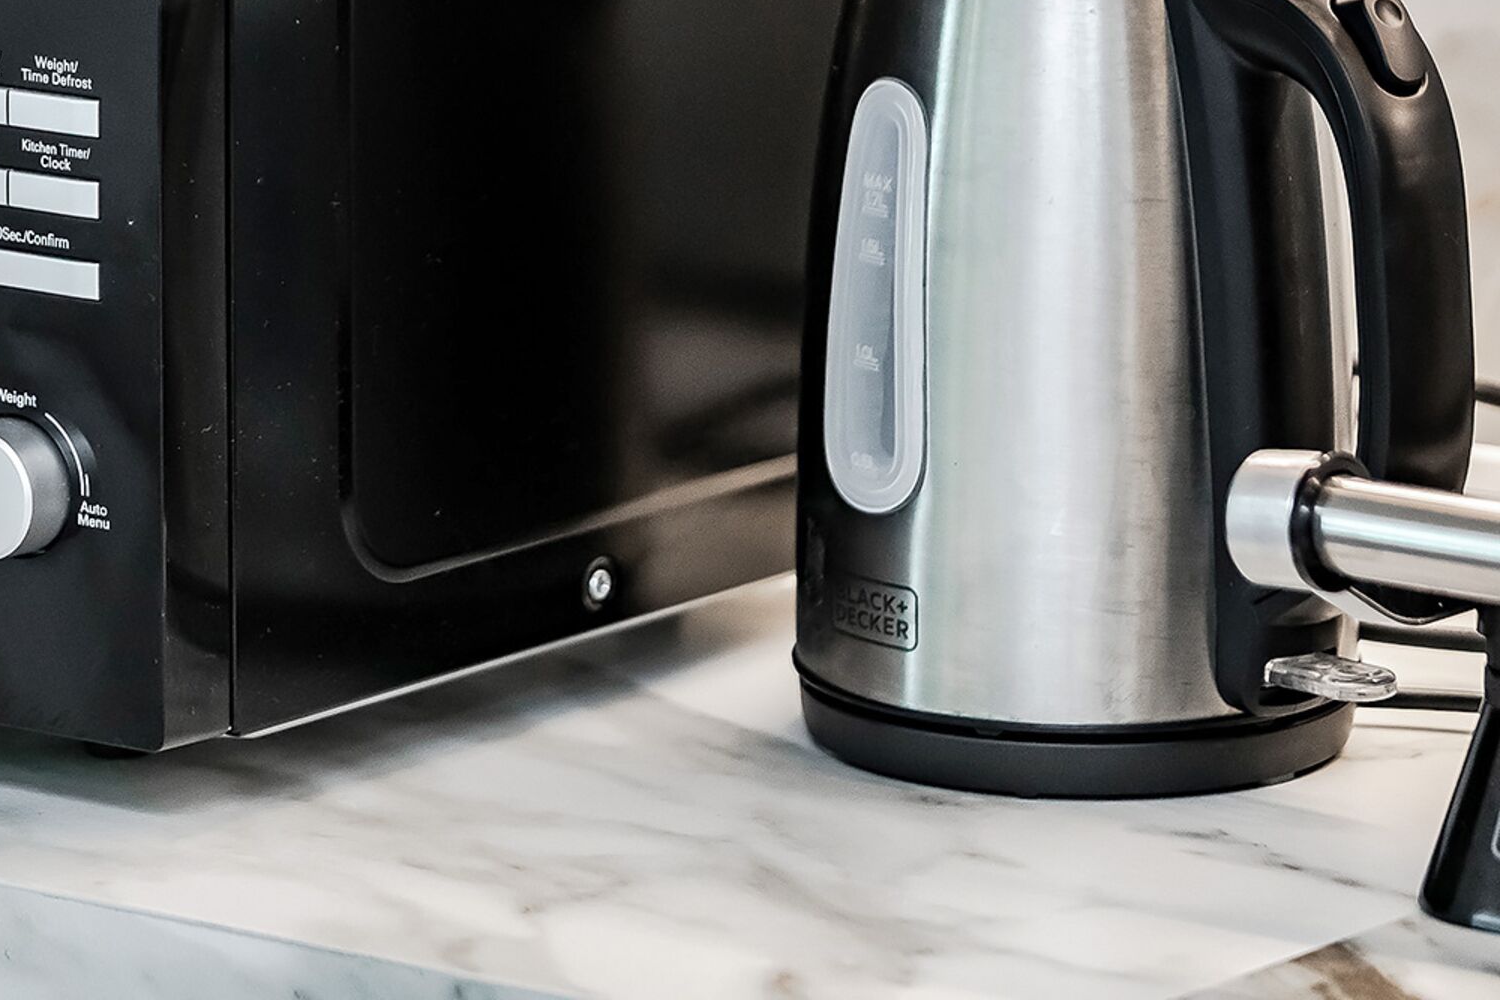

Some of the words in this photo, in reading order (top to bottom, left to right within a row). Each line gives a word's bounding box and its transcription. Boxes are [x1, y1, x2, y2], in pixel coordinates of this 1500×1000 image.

[34, 55, 79, 74] Weight/
[21, 68, 49, 84] Time
[52, 71, 93, 91] Defrost
[21, 138, 57, 156] Kitchen
[59, 142, 91, 160] Timer/
[40, 155, 72, 171] Clock
[79, 500, 108, 517] Auto
[77, 513, 111, 531] Menu
[835, 602, 909, 640] DECKER
